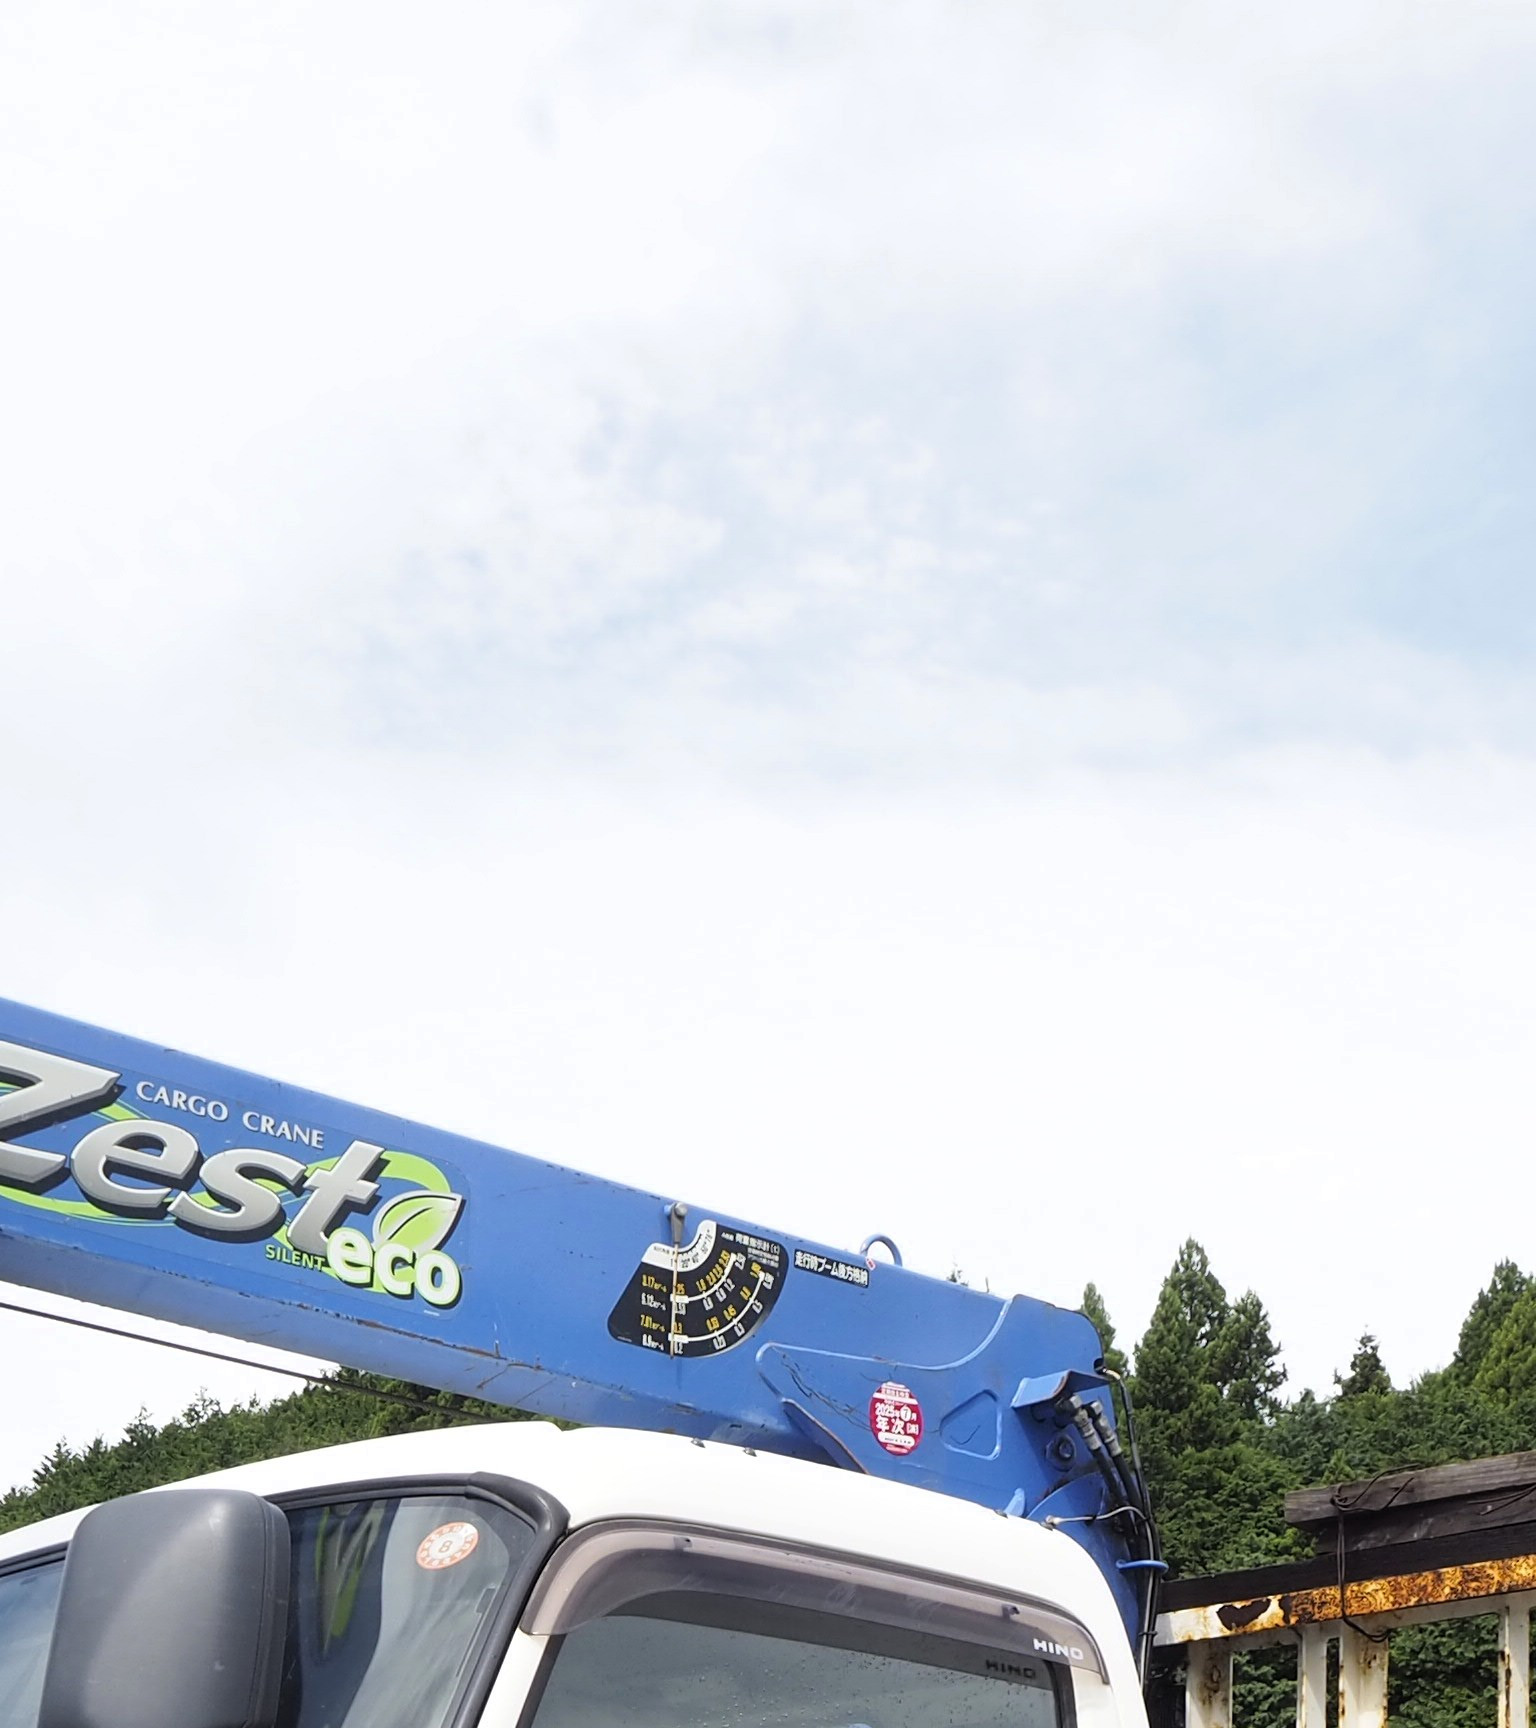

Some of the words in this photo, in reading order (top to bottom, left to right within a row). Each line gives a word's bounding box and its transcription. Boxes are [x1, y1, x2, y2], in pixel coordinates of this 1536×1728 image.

[136, 1080, 229, 1123] CARGO
[242, 1110, 325, 1150] CRANE
[265, 1244, 326, 1272] SILENT
[326, 1227, 462, 1307] eco
[1033, 1638, 1084, 1661] HINO
